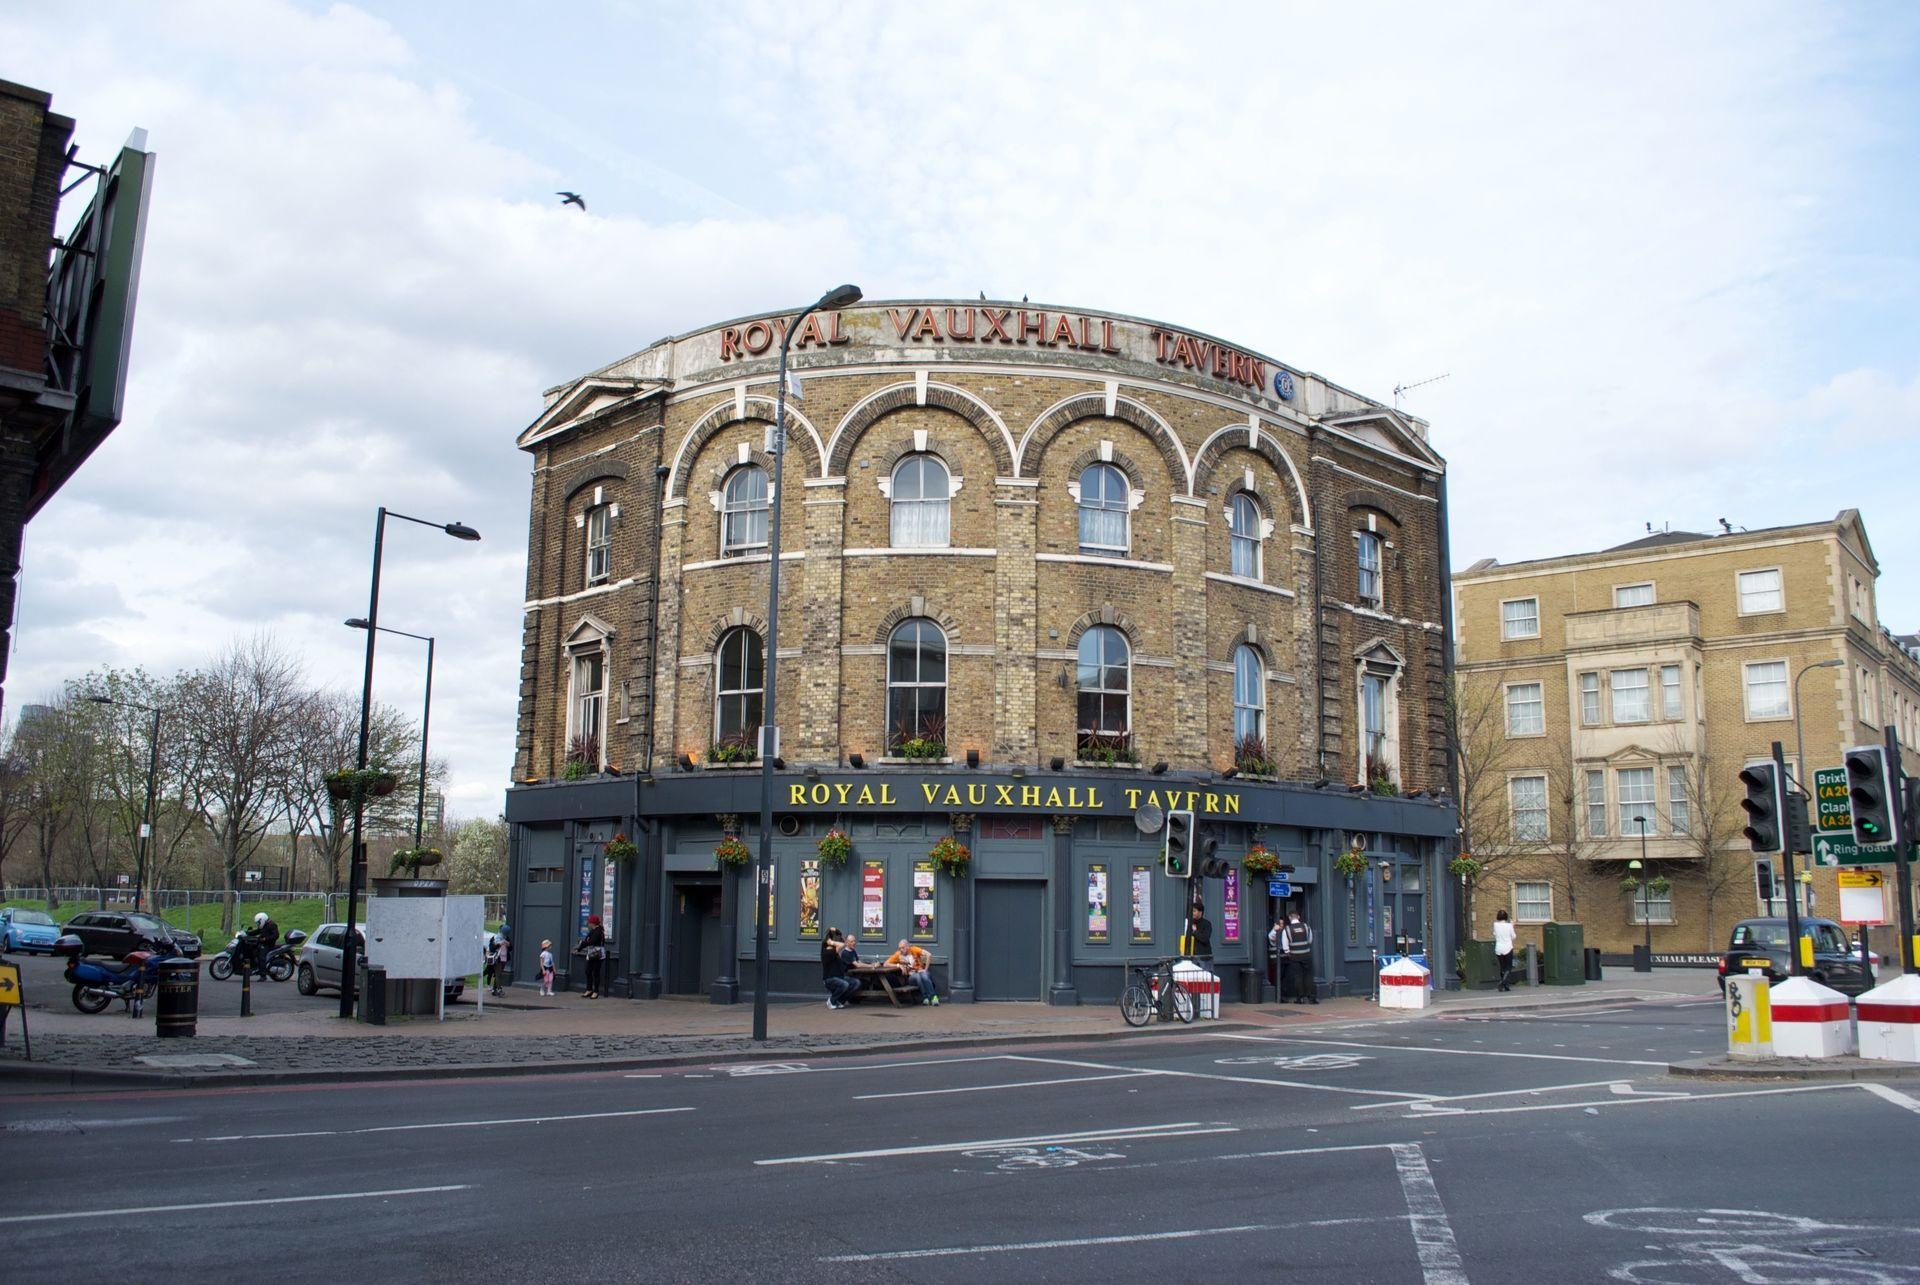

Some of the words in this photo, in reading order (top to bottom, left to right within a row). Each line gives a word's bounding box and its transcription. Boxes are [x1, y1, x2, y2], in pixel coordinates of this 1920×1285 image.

[719, 311, 850, 362] ROYAL
[886, 307, 1122, 354] VAUXHALL
[1150, 327, 1266, 392] TAVERN
[1818, 772, 1846, 785] Brixt
[789, 782, 897, 805] ROYAL
[921, 783, 1104, 808] VAUXHALL
[1124, 788, 1240, 814] TAVERN
[1819, 785, 1849, 799] (A20
[1821, 801, 1851, 814] Claph
[1822, 814, 1851, 828] (A32
[1833, 844, 1858, 856] Ring
[1650, 955, 1687, 963] UXHALL
[1687, 955, 1719, 964] PLEAS
